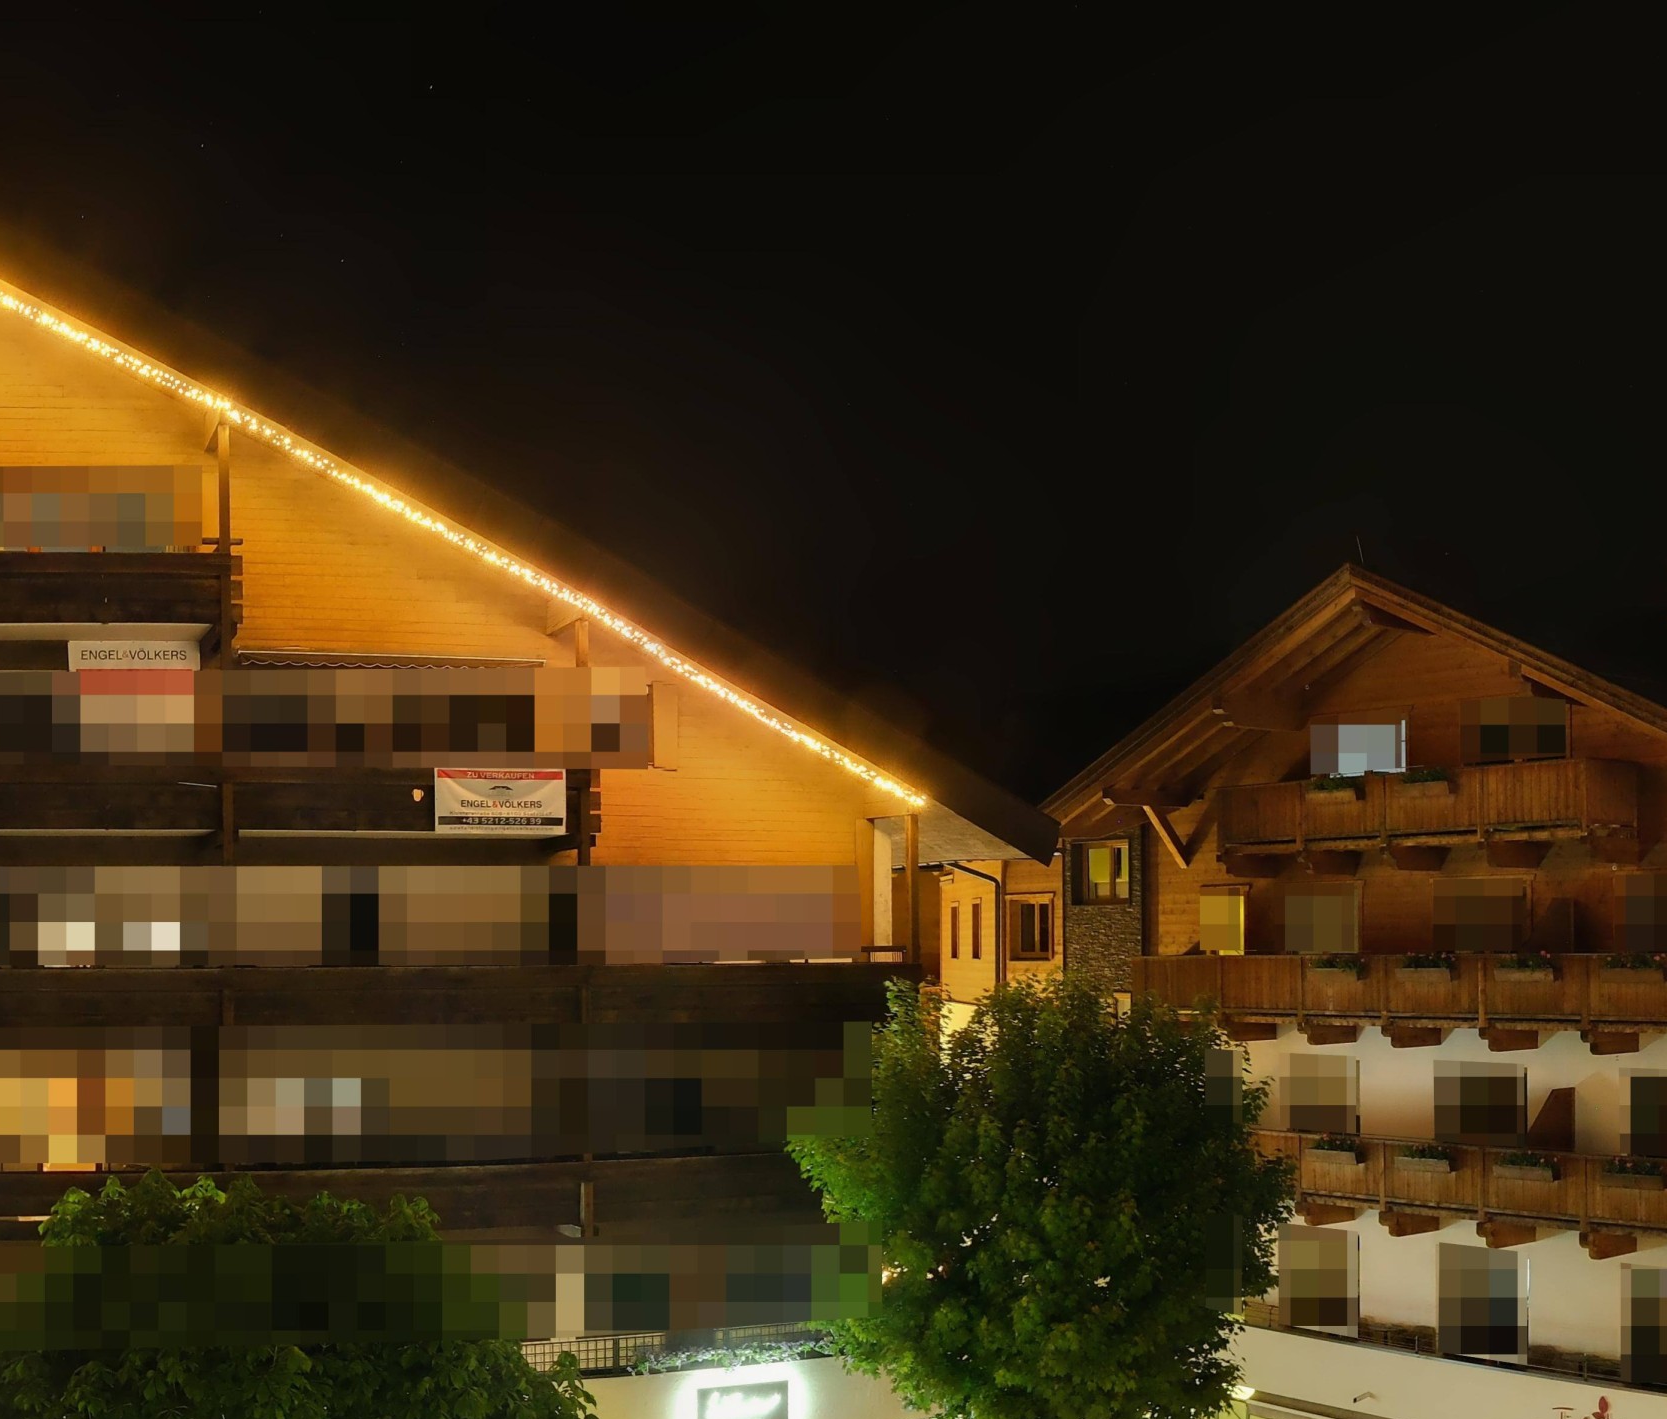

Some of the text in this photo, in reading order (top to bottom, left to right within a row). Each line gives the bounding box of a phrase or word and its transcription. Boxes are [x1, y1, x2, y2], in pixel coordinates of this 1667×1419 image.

[80, 647, 187, 661] ENGEL&VÖLKERS
[467, 772, 535, 781] ZU VERKAUFEN
[460, 799, 543, 809] ENGEL&VÖLKERS
[529, 818, 542, 826] 39
